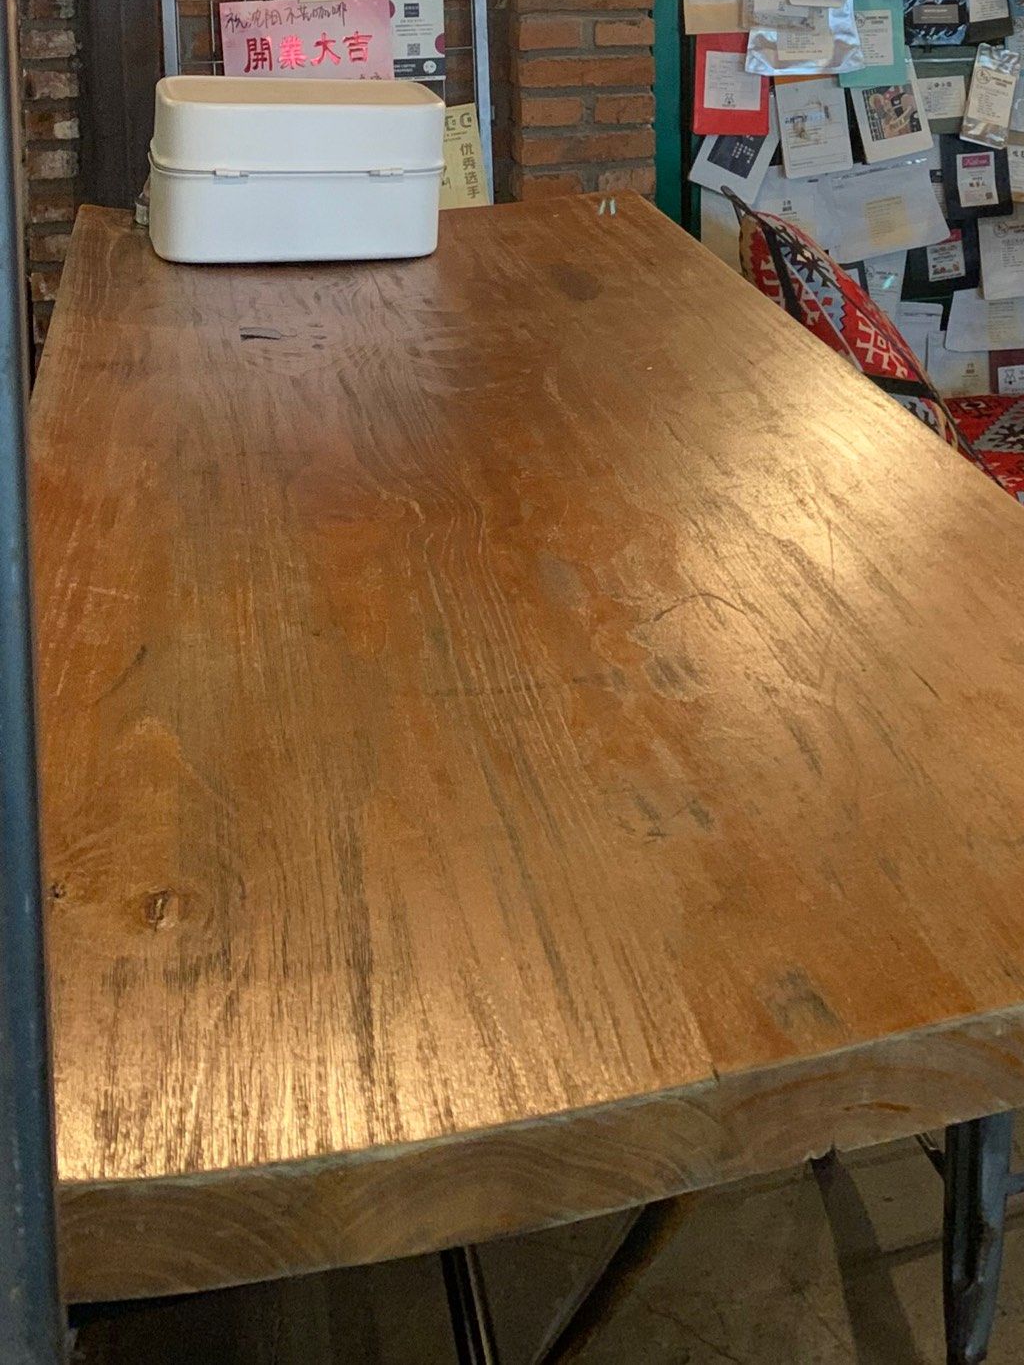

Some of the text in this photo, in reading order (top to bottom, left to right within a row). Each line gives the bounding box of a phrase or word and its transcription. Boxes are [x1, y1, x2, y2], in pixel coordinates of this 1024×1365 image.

[244, 31, 373, 73] 開業大吉
[460, 142, 480, 199] 优秀选手
